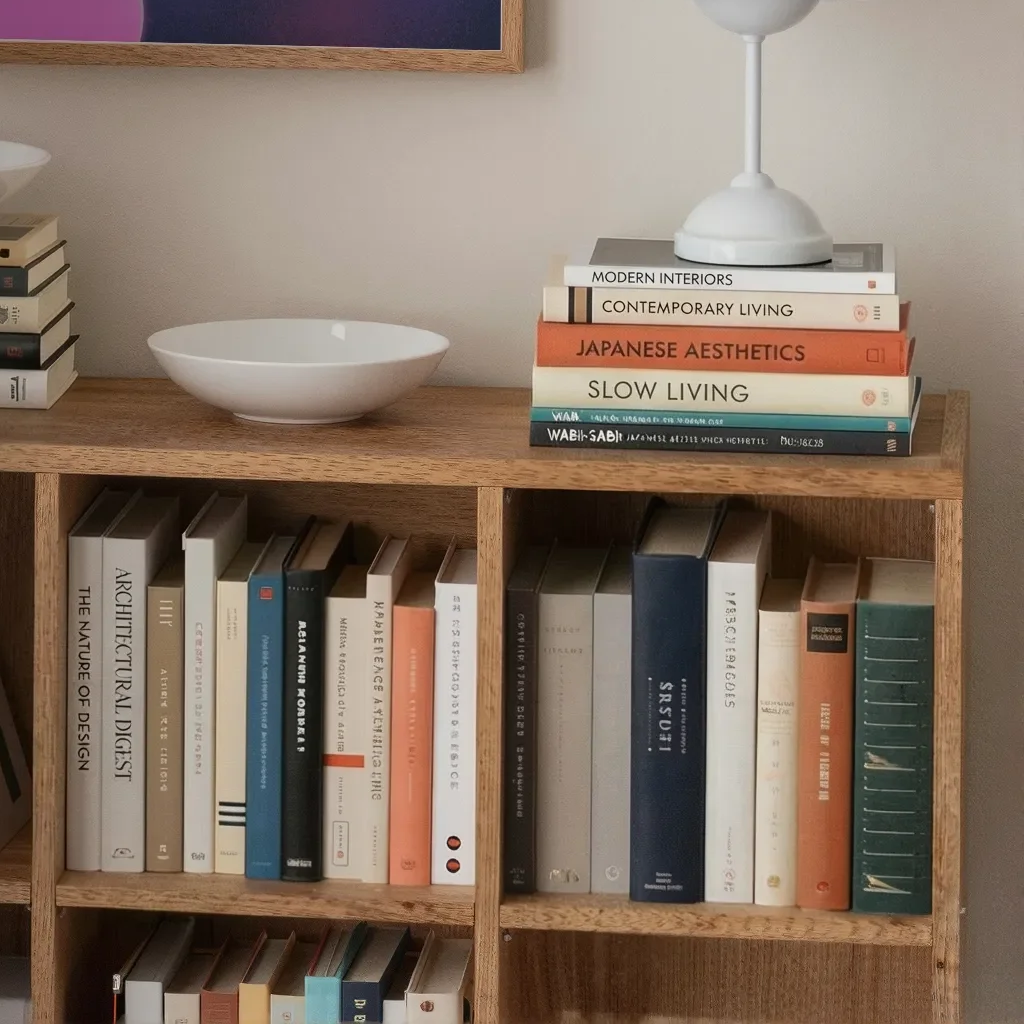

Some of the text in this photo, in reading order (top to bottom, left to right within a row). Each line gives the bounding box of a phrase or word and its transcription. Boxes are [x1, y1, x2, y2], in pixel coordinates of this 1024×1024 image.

[592, 272, 732, 285] MODERN INTERIORS
[602, 300, 793, 316] CONTEMPORARY LIVING
[576, 340, 805, 361] JAPANESE AESTHETICS
[588, 379, 748, 402] SLOW LIVING
[78, 586, 91, 770] THE NATURE OF DESIGN
[115, 568, 132, 781] ARCHITECTURAL DIGEST
